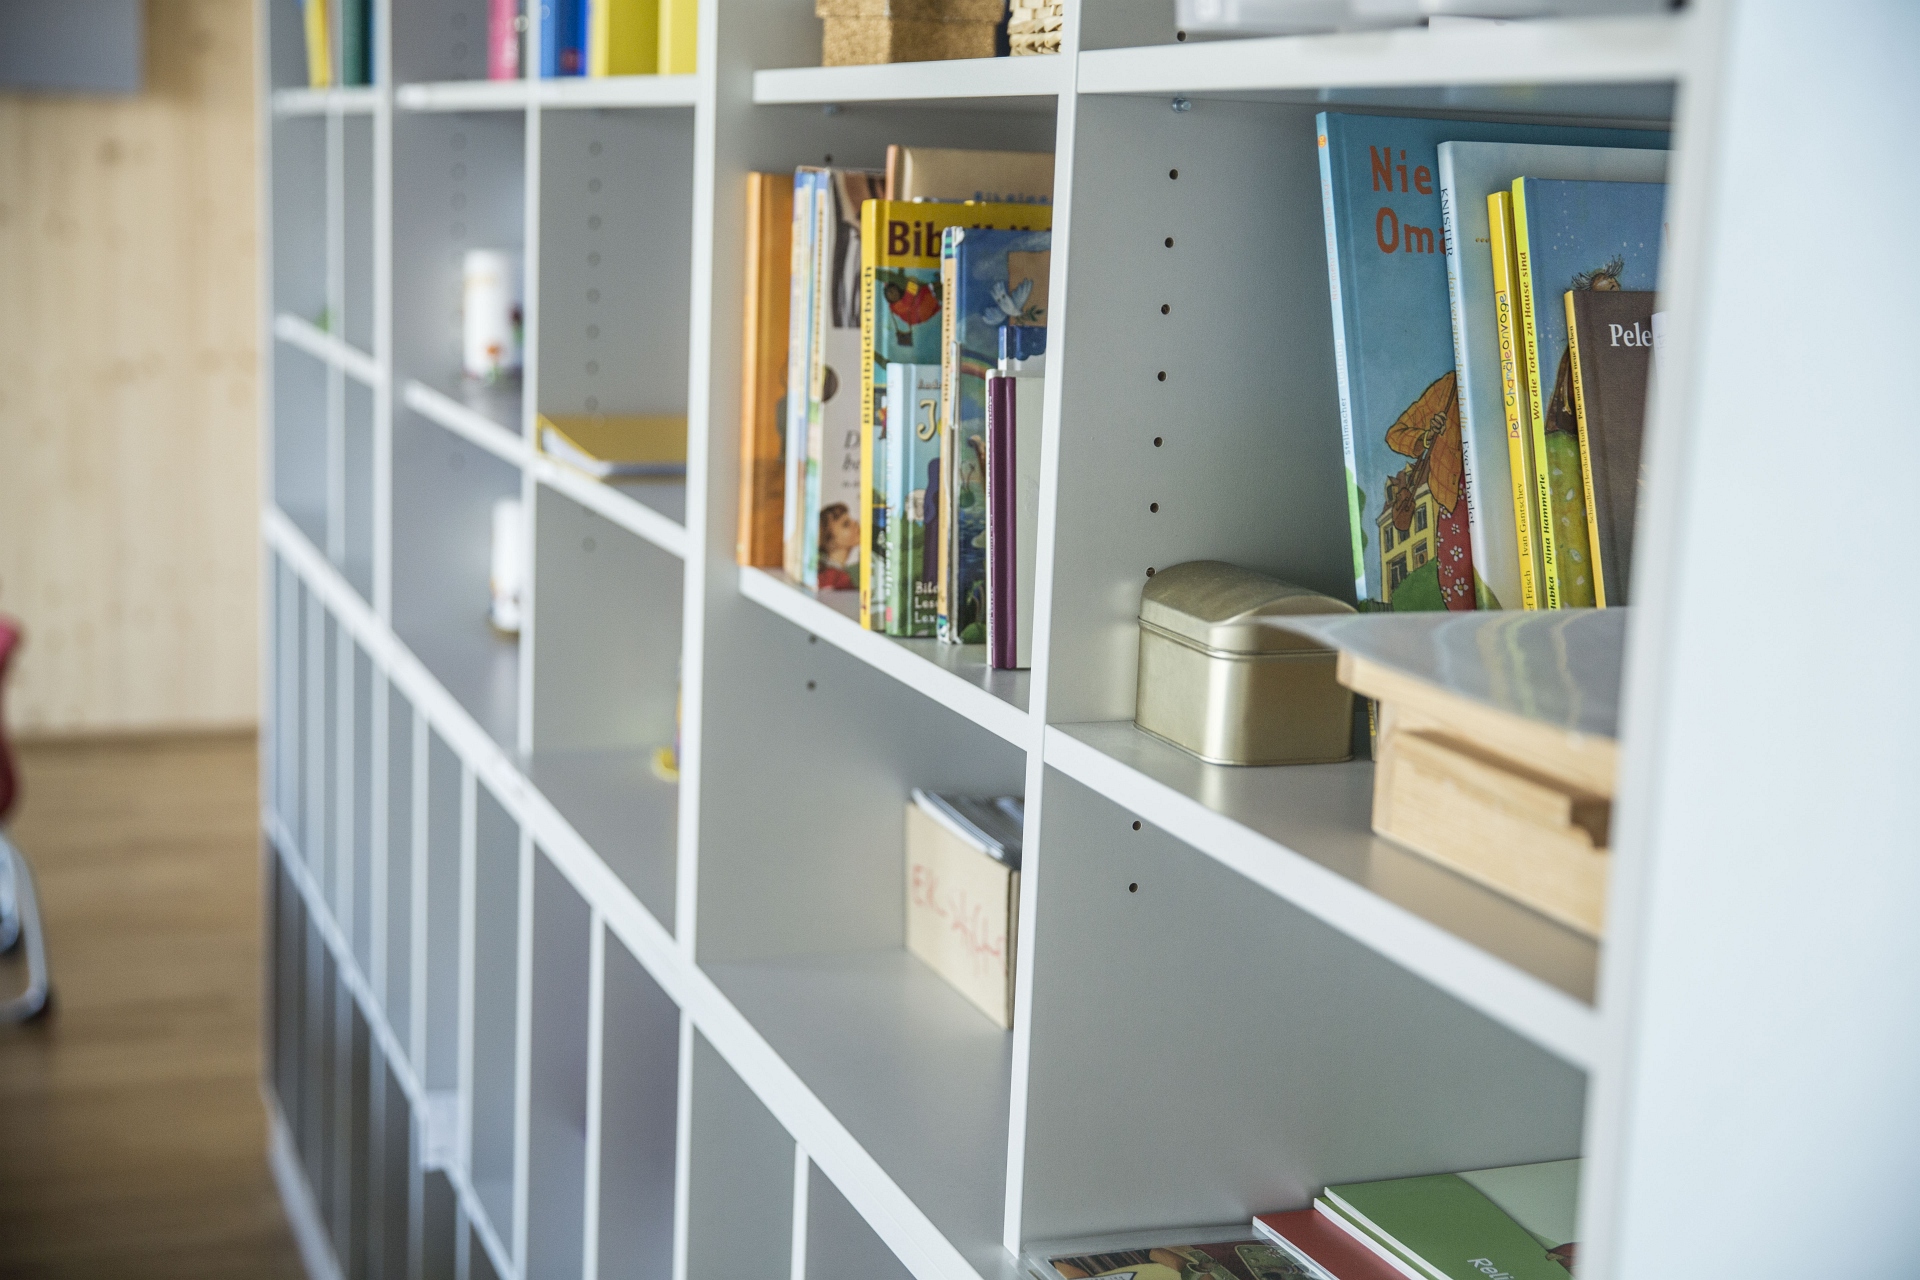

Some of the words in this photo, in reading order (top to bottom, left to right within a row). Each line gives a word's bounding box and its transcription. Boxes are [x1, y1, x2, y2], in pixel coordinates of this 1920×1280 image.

[1369, 145, 1433, 195] Nie
[1520, 252, 1528, 277] sind
[1522, 282, 1532, 318] Hause
[1527, 322, 1533, 336] zu
[1608, 321, 1653, 347] Pele
[863, 265, 873, 424] Bibelbilderbuch
[1441, 188, 1454, 256] KNISTER
[1462, 441, 1470, 466] Eve
[1466, 468, 1476, 525] Tharlet
[1495, 290, 1516, 407] Chamäleonvogel
[1525, 341, 1536, 374] Toten
[1571, 351, 1579, 370] neue
[1574, 386, 1582, 401] und
[1533, 401, 1541, 420] Wo
[1341, 397, 1351, 455] Stellmacher
[1509, 414, 1521, 438] Der
[1517, 483, 1527, 533] Gantschev
[1539, 474, 1550, 533] Hammerle
[1521, 536, 1529, 556] Ivan
[1545, 538, 1553, 564] Nina
[1523, 570, 1533, 599] Frisch
